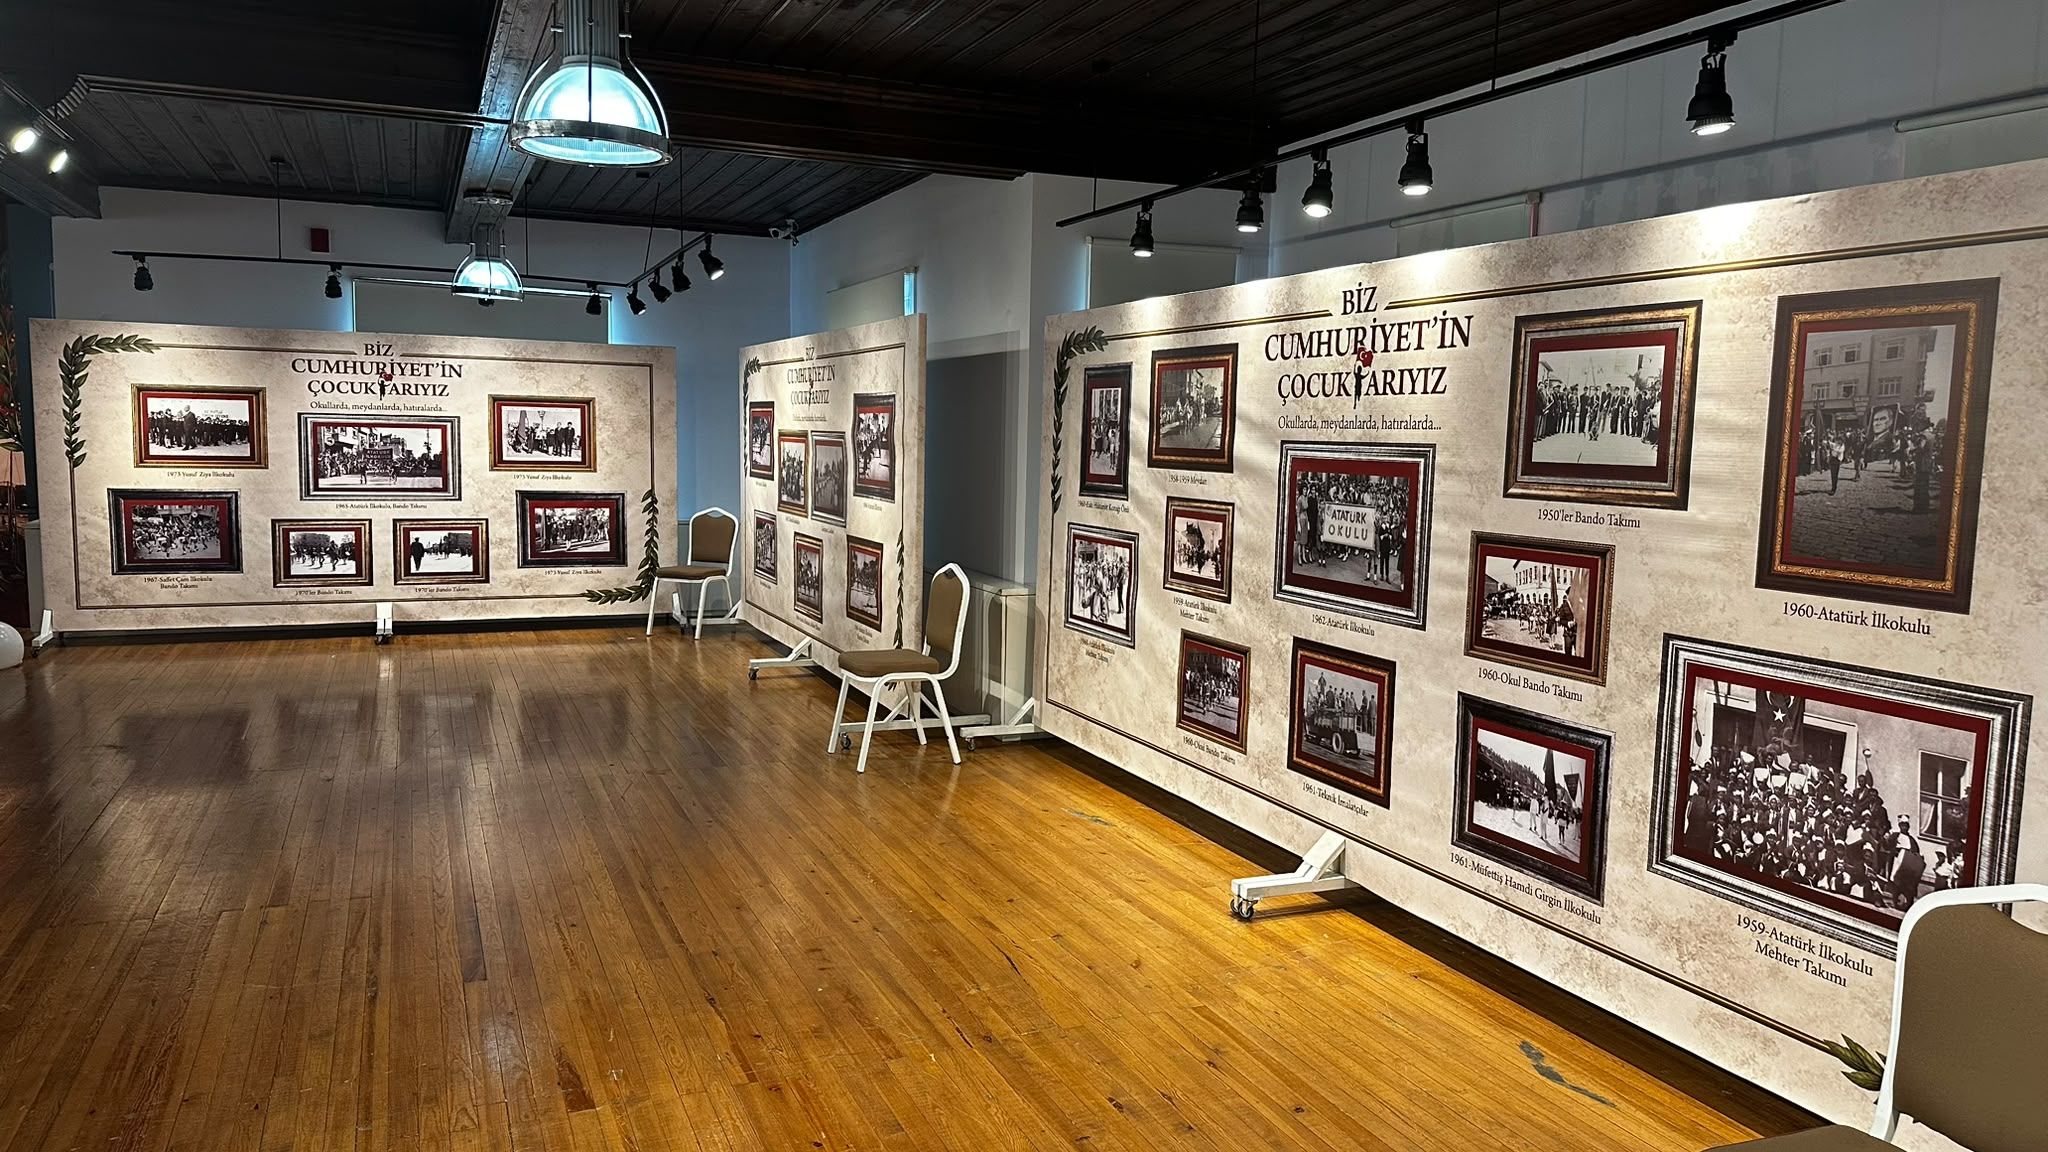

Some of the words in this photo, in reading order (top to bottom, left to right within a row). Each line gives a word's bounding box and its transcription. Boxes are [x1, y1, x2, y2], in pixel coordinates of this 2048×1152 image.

[1341, 282, 1378, 316] BİZ
[364, 341, 394, 357] BİZ
[1264, 310, 1474, 361] CUMHURİYET'İN
[291, 358, 462, 378] CUMHURİYET'İN
[308, 380, 449, 397] ÇOCUKARIYIZ
[1277, 367, 1448, 406] ÇOCUKARIYIZ
[310, 401, 350, 411] Okullarda,
[352, 402, 402, 412] meydanlarda,
[1278, 415, 1319, 430] Okullarda,
[1320, 415, 1379, 433] meydanlarda,
[1381, 413, 1442, 431] hatıralarda...
[1331, 509, 1367, 525] ATATÜRK
[1538, 508, 1574, 522] 1950'ler
[1574, 511, 1605, 526] Bando
[1606, 513, 1641, 528] Takımı
[1328, 524, 1368, 541] OKULU
[1783, 601, 1868, 627] 1960-Atatürk
[1871, 610, 1931, 635] İlkokulu
[1478, 667, 1521, 688] 1960-Okul
[1522, 678, 1550, 694] Bando
[1551, 684, 1583, 702] Takımı
[1450, 852, 1503, 884] 1961-Müfettiş
[1504, 874, 1533, 896] Hamdi
[1534, 887, 1562, 908] Girgin
[1564, 897, 1601, 925] İlkokulu
[1736, 914, 1816, 955] 1959-Atatürk
[1818, 942, 1873, 977] İlkokulu
[1755, 940, 1800, 969] Mehter
[1802, 958, 1847, 987] Takımı
